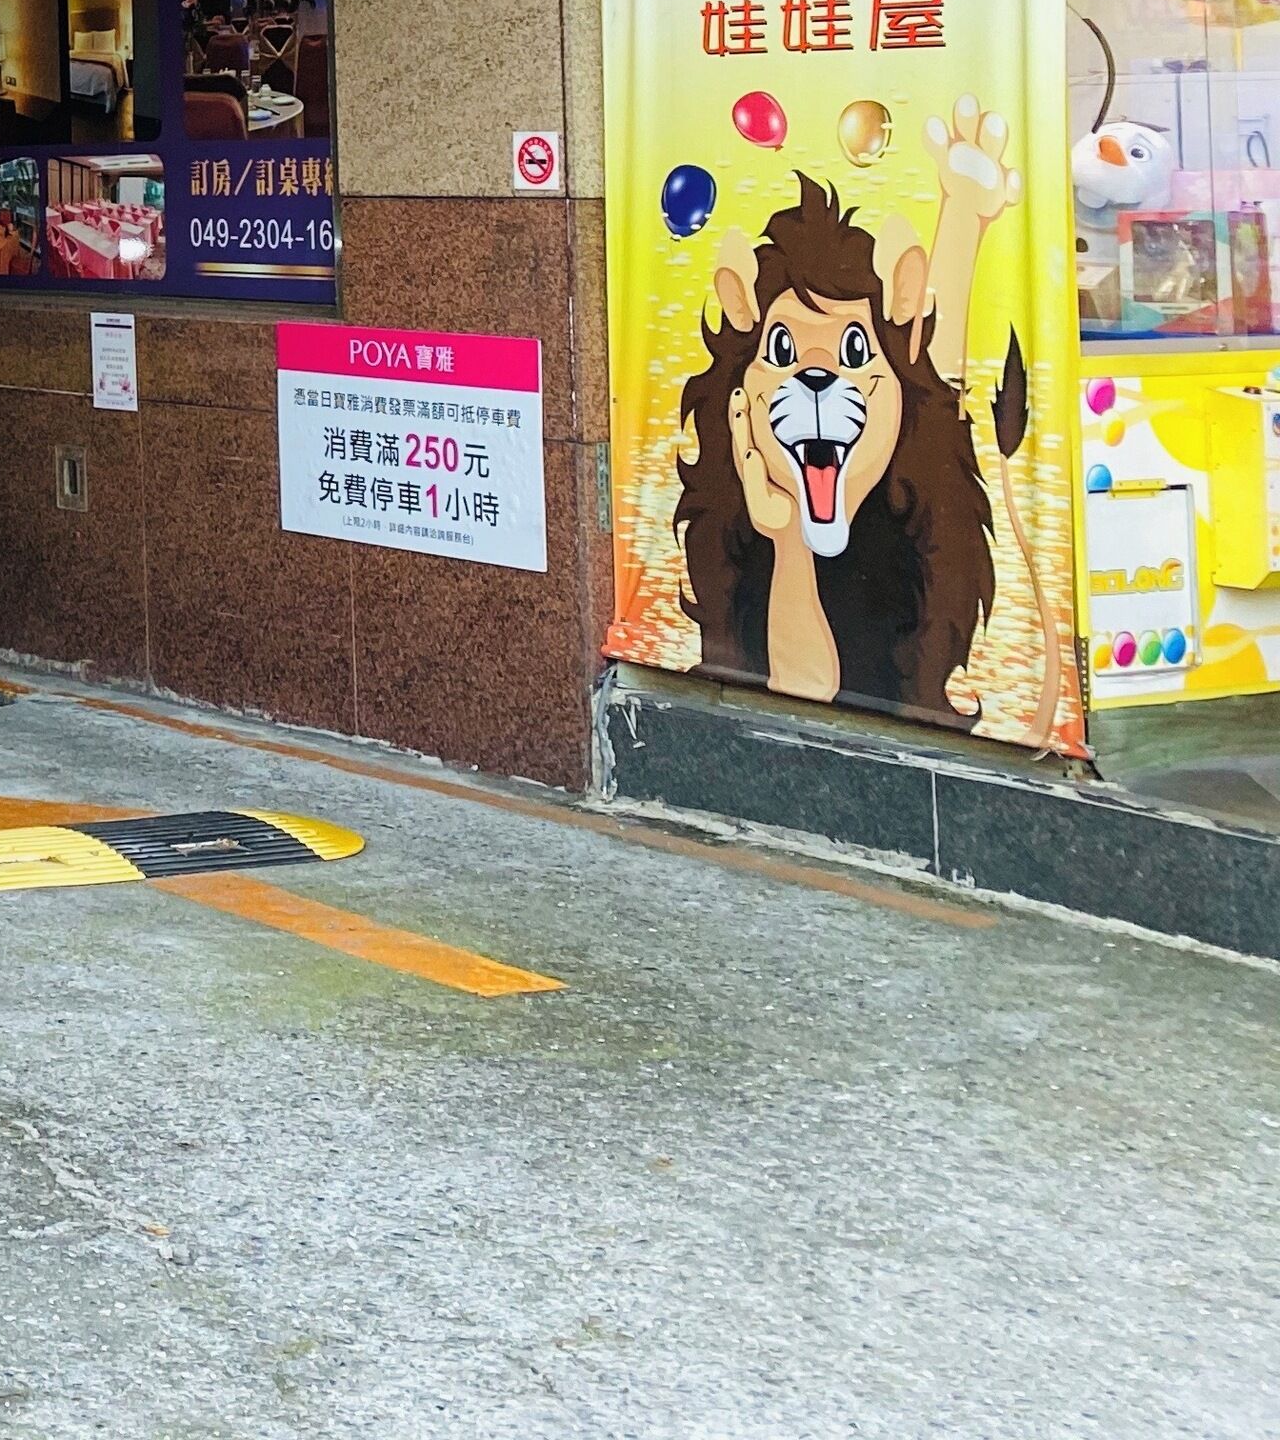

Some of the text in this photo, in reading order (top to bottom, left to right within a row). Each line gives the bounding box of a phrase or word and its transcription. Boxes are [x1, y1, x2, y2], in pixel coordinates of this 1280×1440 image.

[349, 339, 456, 374] POYA 寶雅
[323, 426, 490, 479] 消費滿250元
[318, 469, 500, 528] 免費停車1小時
